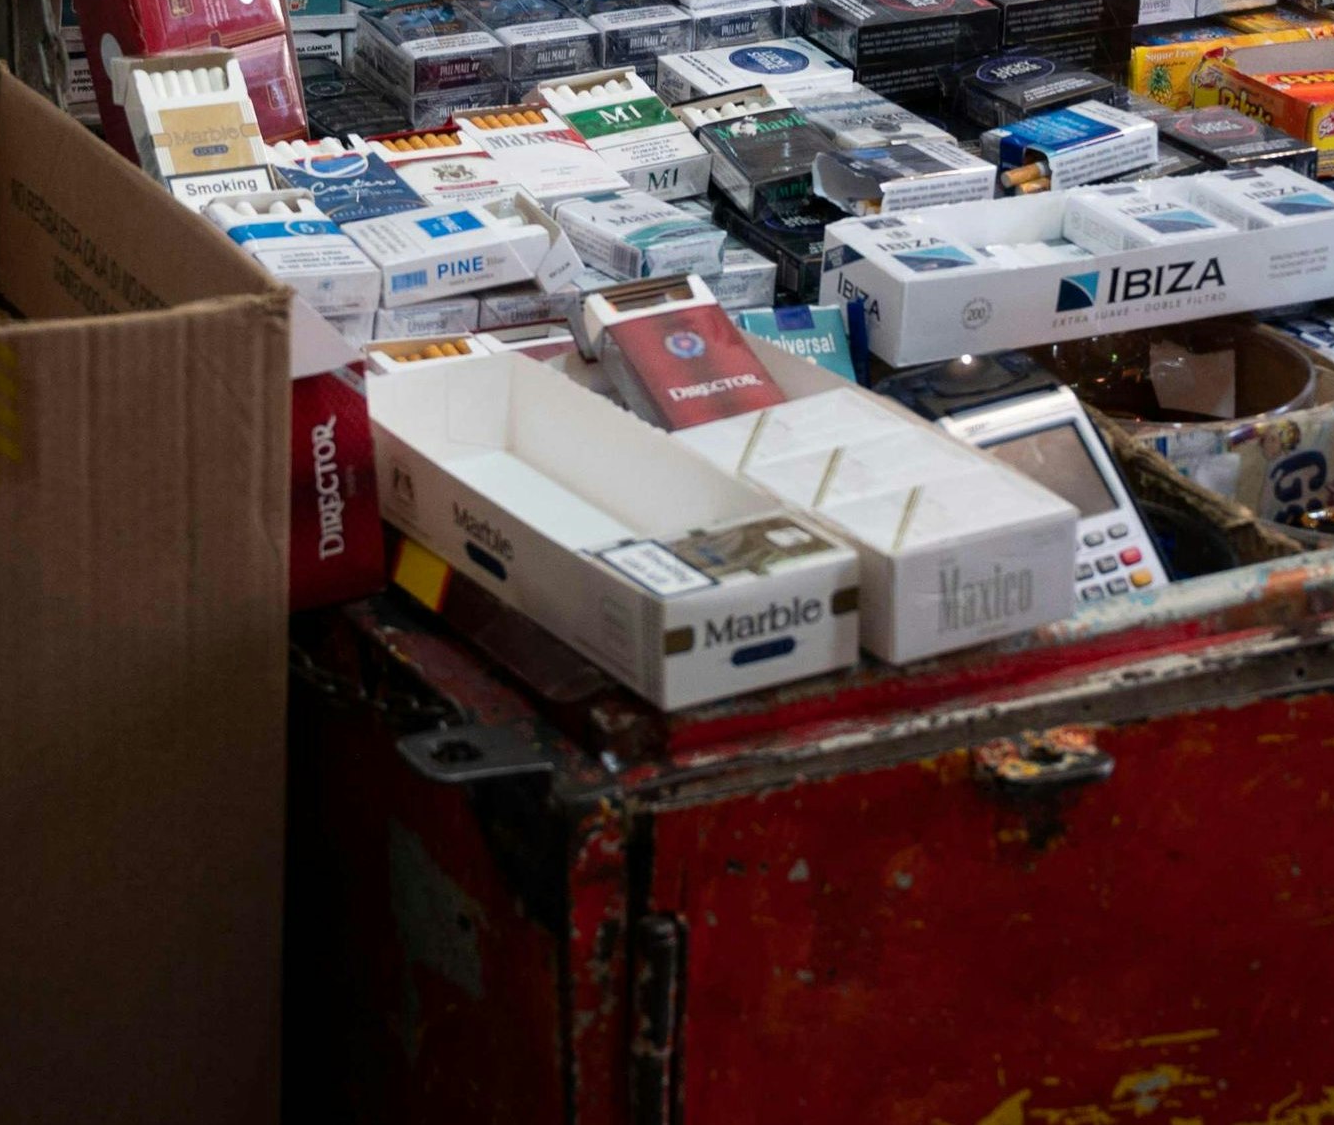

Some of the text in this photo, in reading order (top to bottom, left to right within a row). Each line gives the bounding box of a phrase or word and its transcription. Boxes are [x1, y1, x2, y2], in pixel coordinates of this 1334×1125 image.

[175, 124, 242, 147] Marble
[185, 176, 259, 197] Smoking
[1119, 201, 1179, 217] IBIZA
[875, 235, 946, 253] IBIZA
[437, 256, 483, 280] PINE
[1107, 257, 1227, 303] IBIZA
[835, 271, 881, 323] IBIZA
[1051, 313, 1090, 329] EXTRA
[1094, 308, 1129, 323] SUAVE
[1143, 300, 1181, 315] DOBLE
[1185, 291, 1228, 308] FILTRO
[669, 372, 762, 403] DIRECTOR
[311, 413, 344, 562] DIRECTOR
[938, 567, 1033, 634] Maxico
[704, 590, 823, 649] Marble
